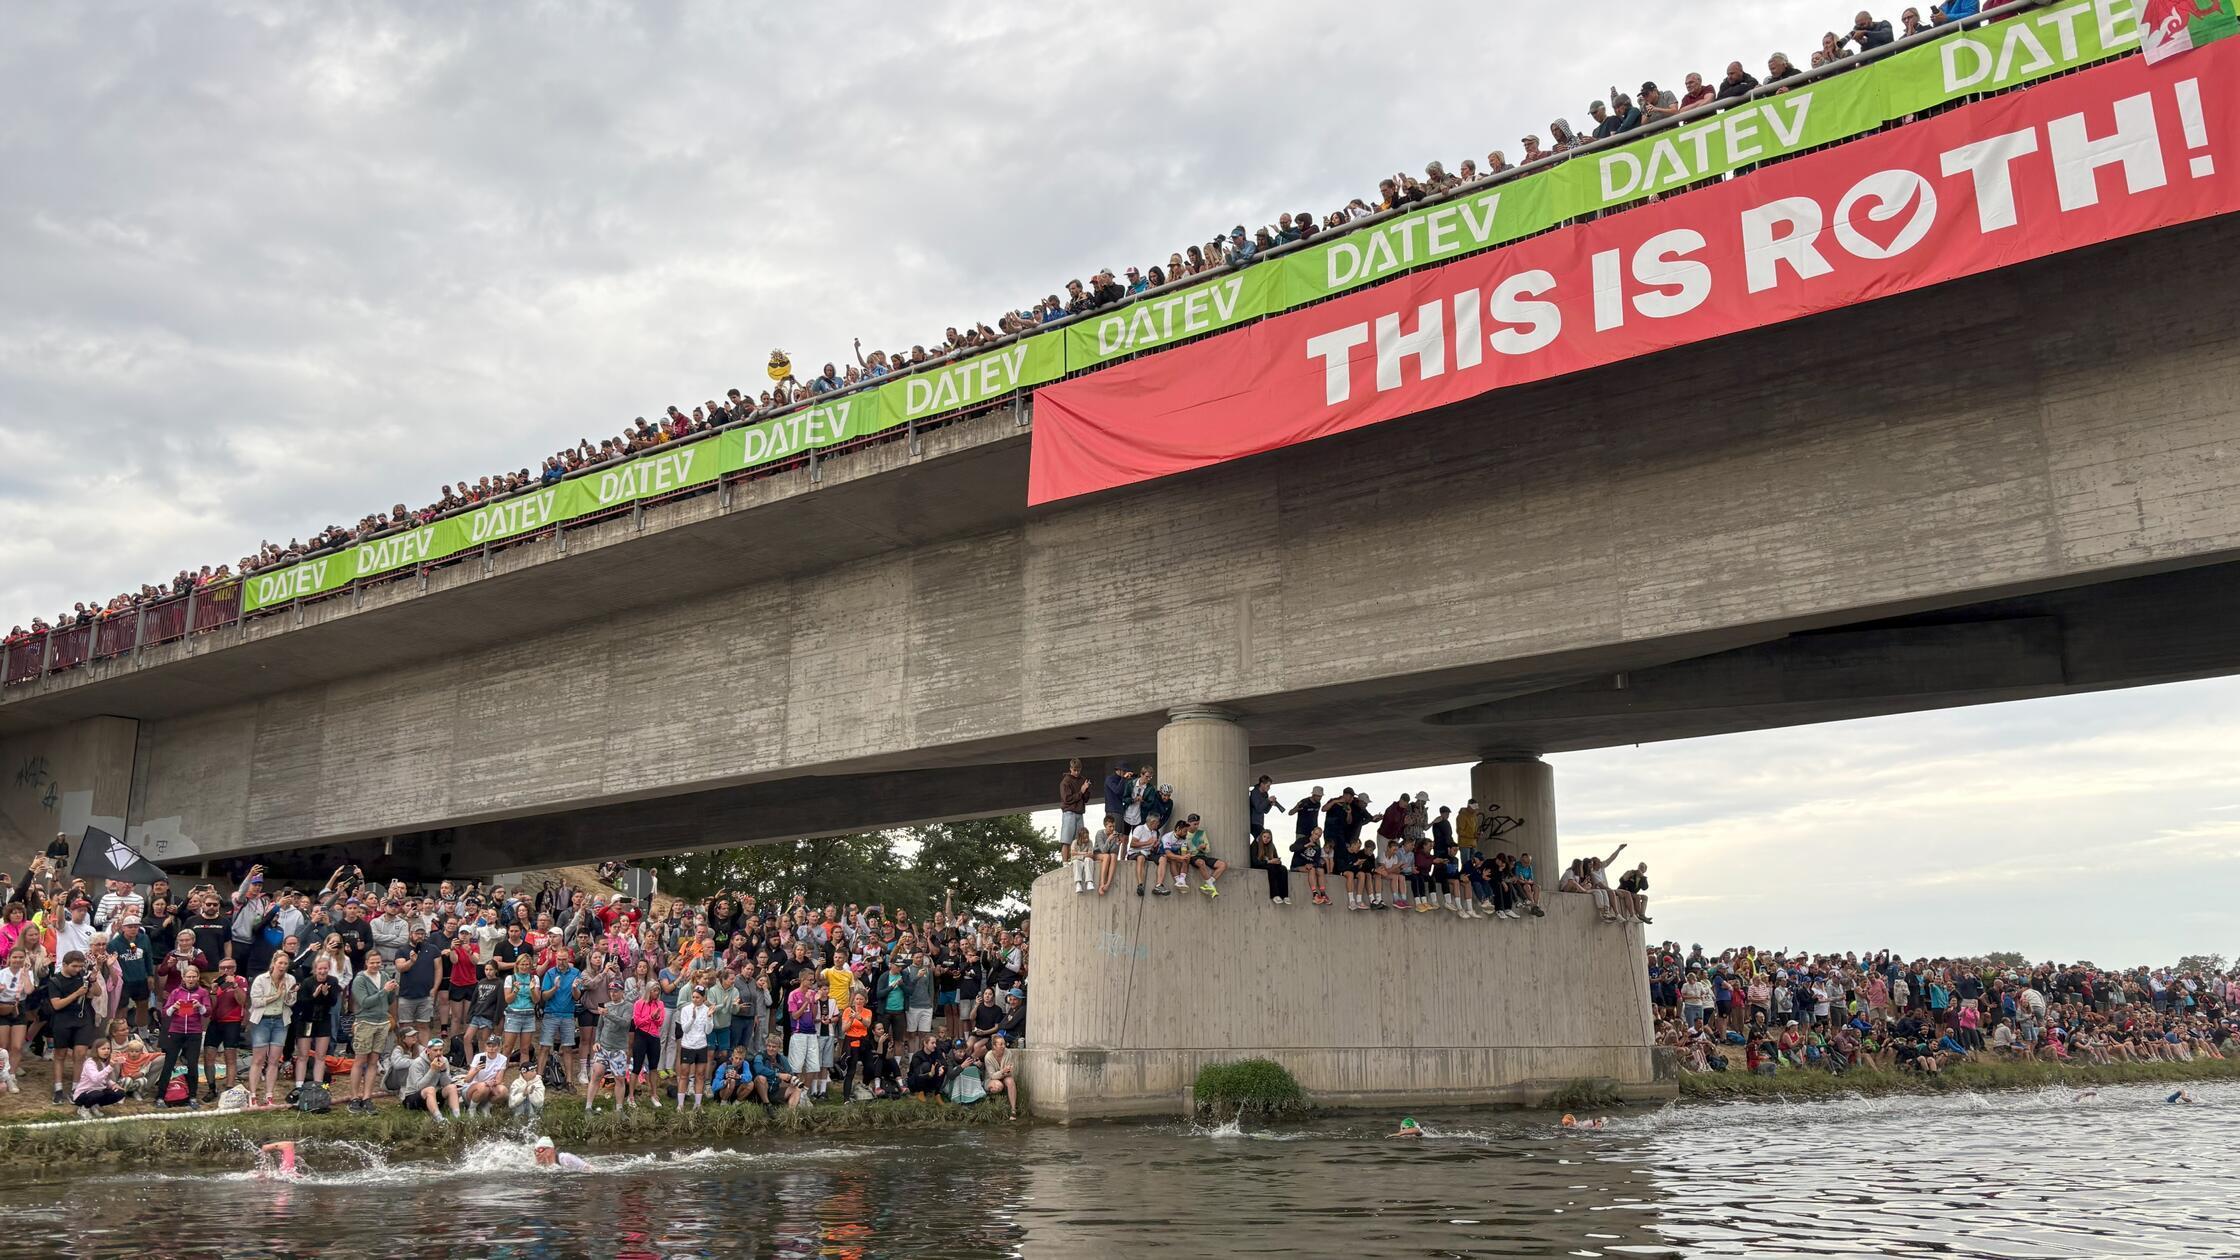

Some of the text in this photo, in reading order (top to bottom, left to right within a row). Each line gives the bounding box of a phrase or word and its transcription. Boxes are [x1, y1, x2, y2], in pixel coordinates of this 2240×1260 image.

[1940, 0, 2141, 93] DATE
[1599, 92, 1813, 201] DATEV
[1306, 77, 2215, 407] THIS IS ROTH!
[1327, 193, 1501, 289] DATEV
[1097, 276, 1244, 356] DATEV
[906, 344, 1028, 416] DATEV
[743, 400, 851, 466] DATEV
[598, 448, 695, 505] DATEV
[358, 527, 435, 574] DATEV
[471, 490, 556, 542] DATEV
[258, 559, 328, 604] DATEV
